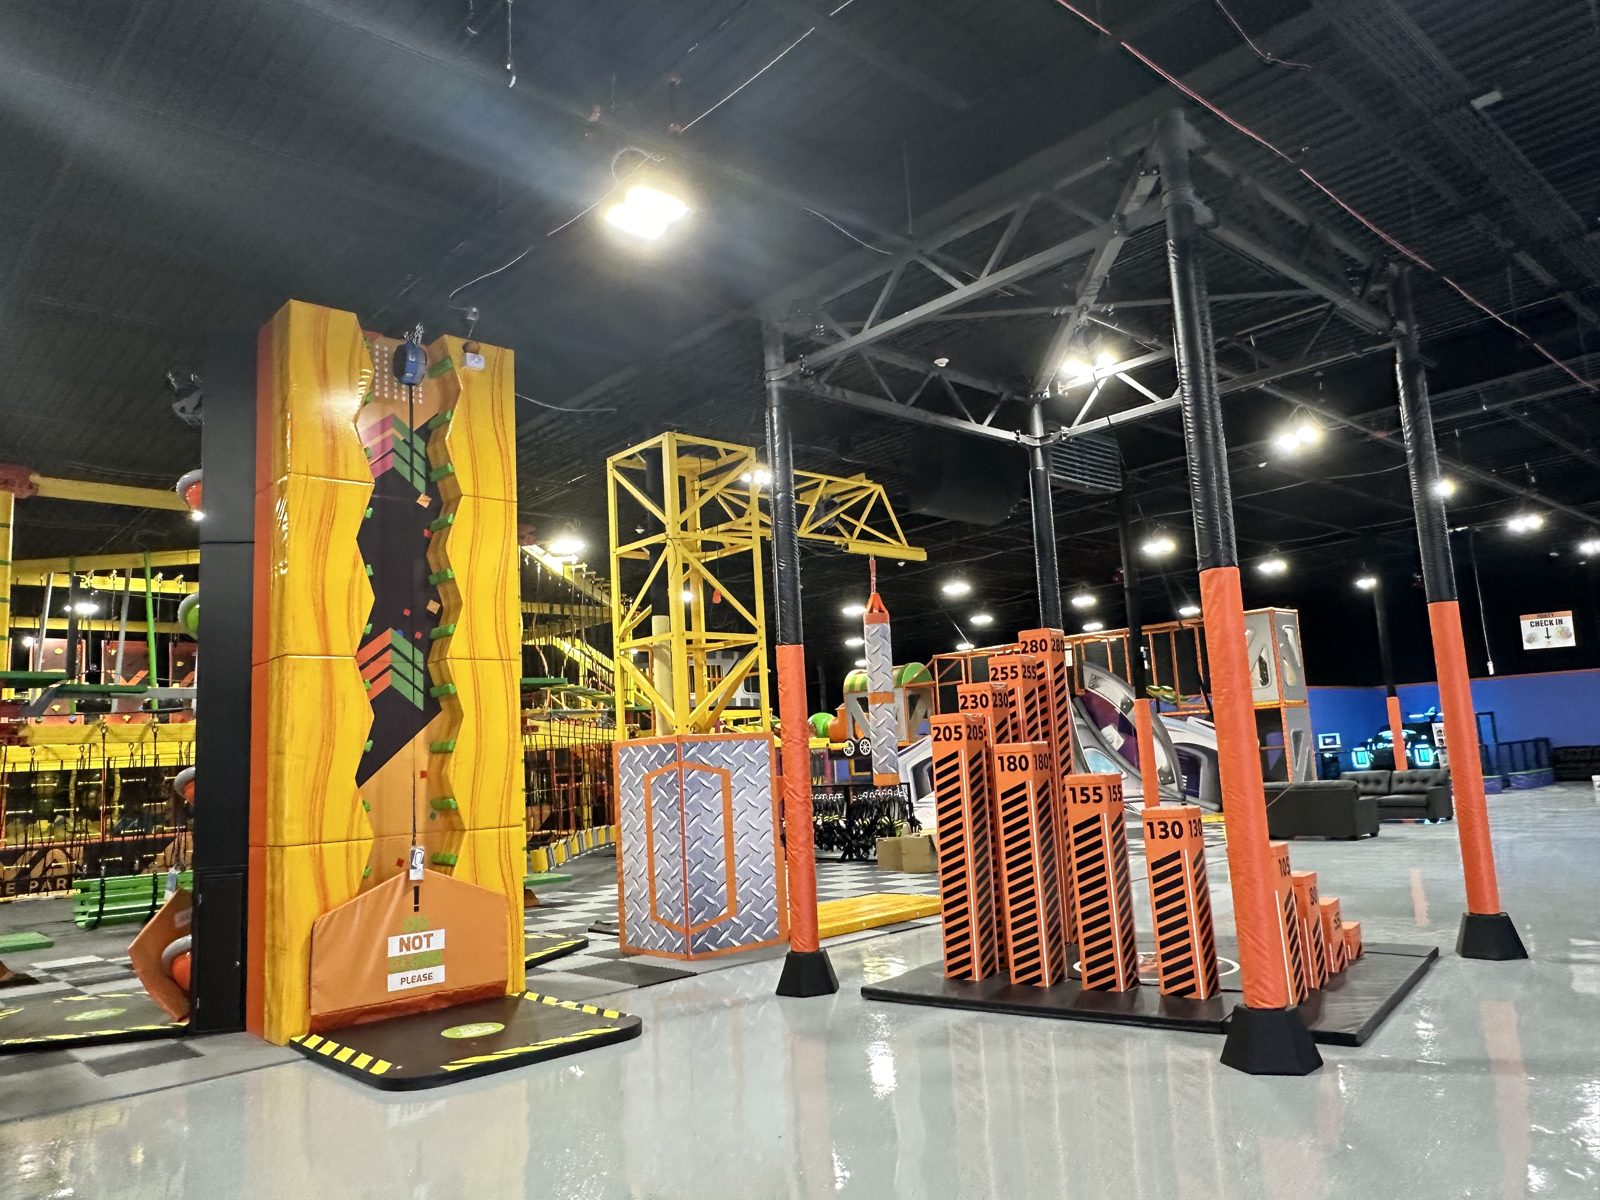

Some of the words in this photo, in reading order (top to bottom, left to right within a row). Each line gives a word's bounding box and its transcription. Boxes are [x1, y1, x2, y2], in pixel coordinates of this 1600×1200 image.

[1530, 619, 1554, 627] CHECK
[1555, 618, 1564, 626] IN
[1020, 639, 1048, 653] 280
[1051, 638, 1065, 653] 280
[990, 665, 1019, 681] 255
[1022, 664, 1037, 680] 255
[959, 694, 989, 710] 230
[992, 692, 1009, 708] 230
[932, 725, 963, 742] 205
[966, 724, 984, 742] 205
[997, 755, 1029, 772] 180
[1034, 753, 1050, 771] 180
[1068, 786, 1104, 804] 155
[1108, 784, 1123, 803] 155
[1146, 820, 1184, 840] 130
[1188, 818, 1204, 838] 130
[1278, 856, 1291, 877] 105
[29, 878, 68, 893] PAR
[399, 933, 434, 953] NOT
[400, 972, 433, 986] PLEASE
